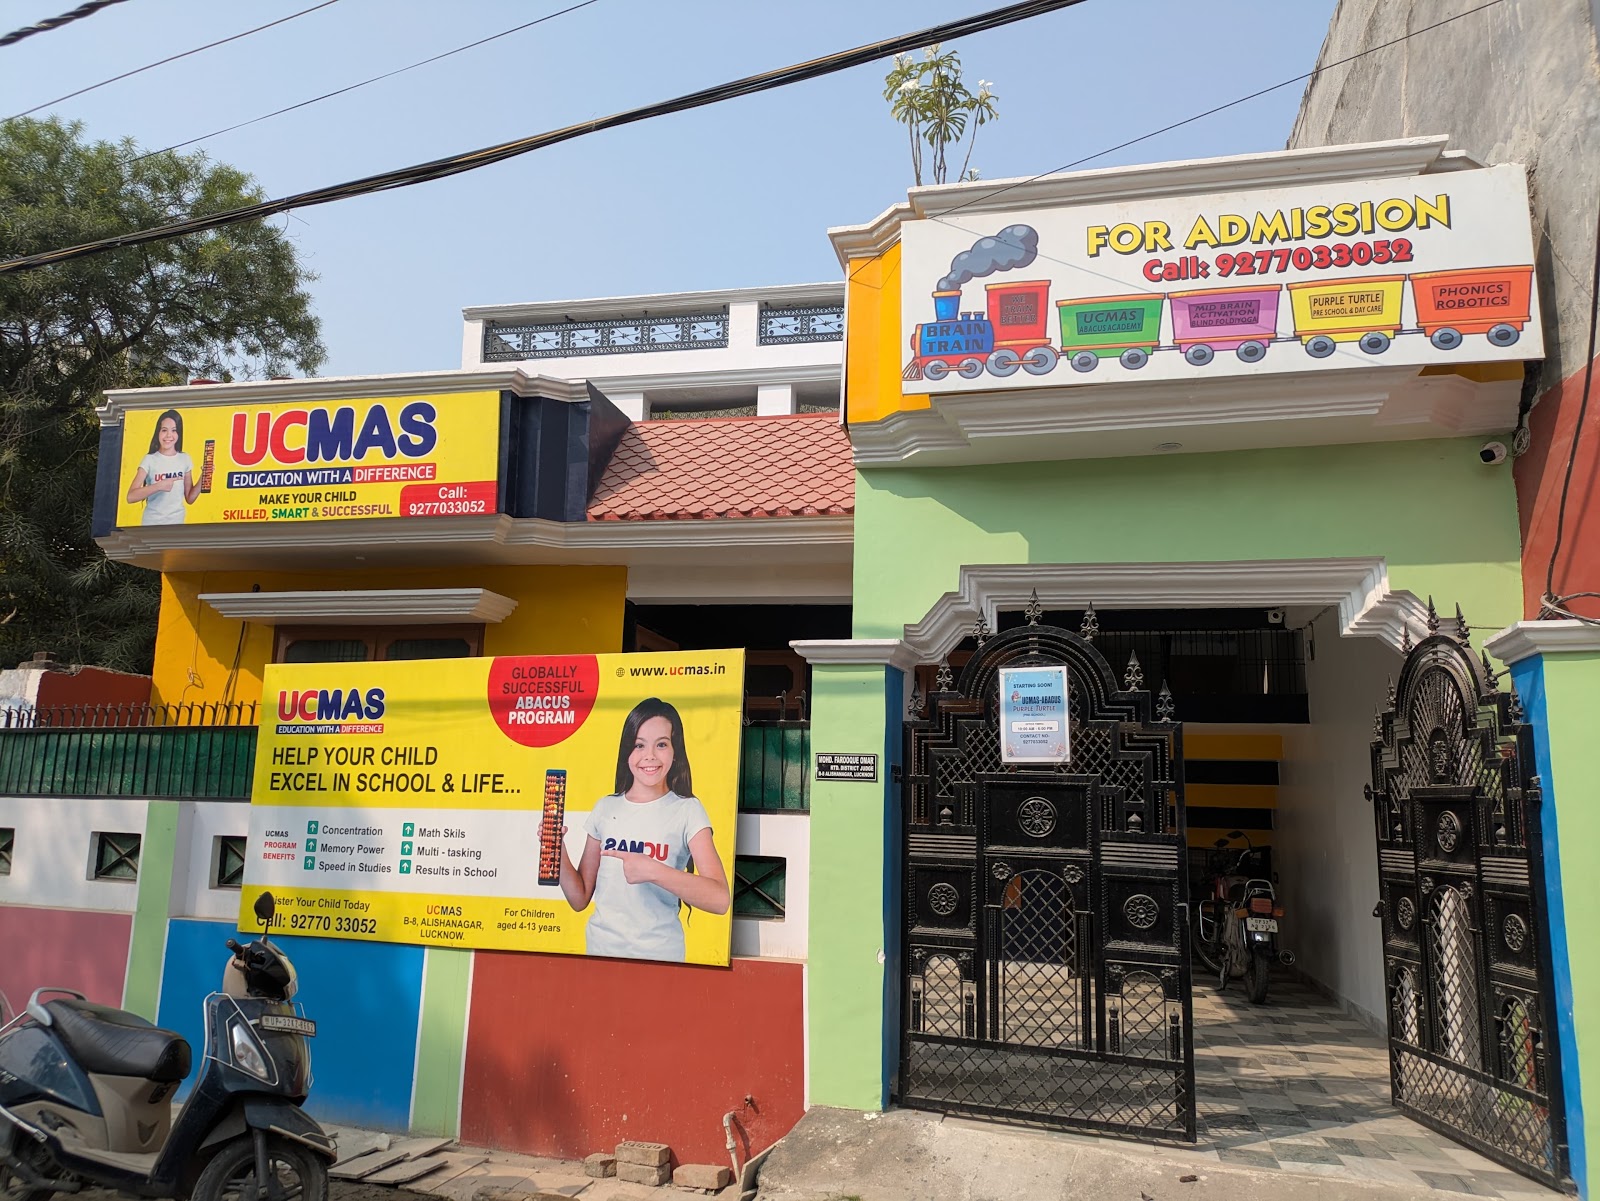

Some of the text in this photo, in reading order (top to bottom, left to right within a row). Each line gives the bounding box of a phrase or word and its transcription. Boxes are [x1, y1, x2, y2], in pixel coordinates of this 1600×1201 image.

[1087, 193, 1451, 257] FOR ADMISSION
[1143, 238, 1414, 282] Call: 9277033052
[1439, 283, 1504, 297] PHONICS
[1220, 301, 1253, 310] BRAIN
[1313, 293, 1381, 307] PURPLE TURTLE
[1437, 295, 1508, 309] ROBOTICS
[1005, 304, 1033, 313] TRAIN
[1193, 308, 1255, 319] ACTIVATION
[1324, 307, 1348, 316] SCHOOL
[1355, 306, 1366, 314] DAY
[1001, 314, 1037, 324] BETTER
[1083, 310, 1137, 323] UCMAS
[1191, 319, 1214, 327] BLIND
[926, 322, 986, 337] BRAIN
[1079, 322, 1142, 333] ABACUS ACADEMY
[926, 338, 984, 353] TRAIN
[231, 402, 437, 465] UCMAS
[232, 465, 434, 487] EDUCATION WITH A DIFFERENCE
[259, 490, 357, 505] MAKE YOUR CHILD
[438, 486, 468, 500] Call:
[223, 504, 392, 521] SKILLED, SMART & SUCCESSFUL
[409, 500, 485, 515] 9277033052
[511, 665, 578, 679] GLOBALLY
[629, 663, 726, 677] www.ucmas.in
[502, 681, 585, 694] SUCCESSFUL
[278, 688, 385, 722] UCMAS
[515, 696, 570, 709] ABACUS
[508, 710, 575, 725] PROGRAM
[278, 724, 383, 734] EDUCATION WITH A DIFFERENCE
[272, 747, 438, 766] HELP YOUR CHILD
[860, 757, 874, 765] OMAR
[270, 773, 521, 794] EXCEL IN SCHOOL & LIFE...
[265, 830, 289, 838] UCMAS
[322, 825, 383, 836] Concentration
[418, 828, 466, 838] Math Skils
[320, 843, 385, 856] Memory Power
[416, 846, 440, 857] Multi
[447, 848, 482, 861] tasking
[263, 852, 295, 861] BENEFITS
[318, 861, 392, 873] Speed in Studies
[415, 865, 497, 878] Results in School
[295, 897, 316, 907] Your
[318, 898, 341, 909] Child
[343, 899, 370, 912] Today
[426, 905, 462, 916] UCMAS
[504, 908, 555, 919] For Children
[290, 913, 331, 931] 92770
[335, 916, 377, 934] 33052
[403, 917, 484, 931] B-8, ALISHANAGAR,
[496, 921, 561, 933] aged 4-13 years
[420, 930, 465, 940] LUCKNOW.
